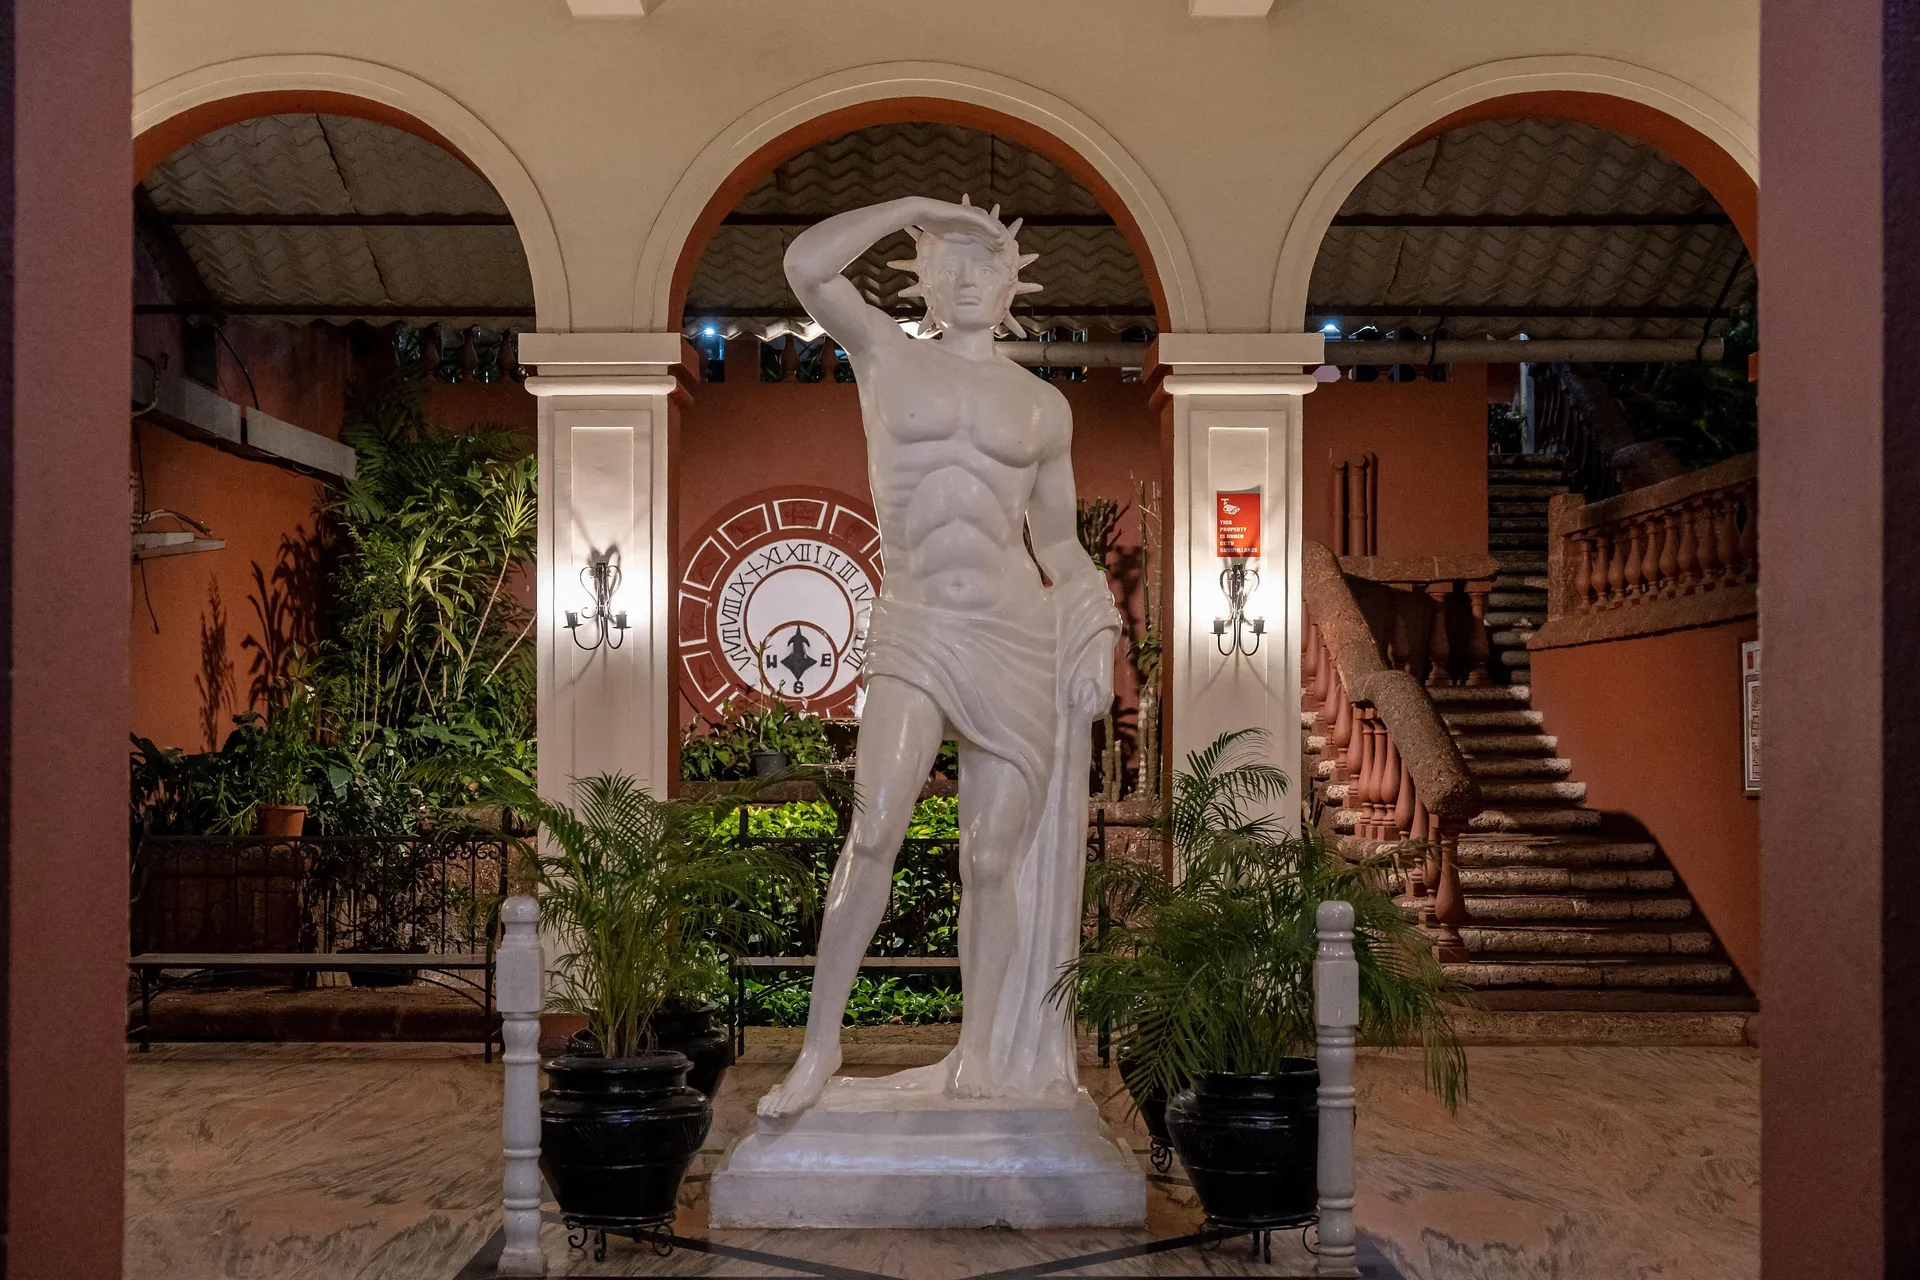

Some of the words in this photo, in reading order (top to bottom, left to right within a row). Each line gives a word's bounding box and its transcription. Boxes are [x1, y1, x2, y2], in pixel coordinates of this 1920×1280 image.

[744, 561, 764, 579] X
[786, 543, 812, 562] XII
[814, 545, 822, 564] I
[822, 550, 840, 571] II
[836, 560, 860, 584] III
[766, 655, 777, 669] W
[820, 653, 832, 667] E
[793, 681, 804, 694] S
